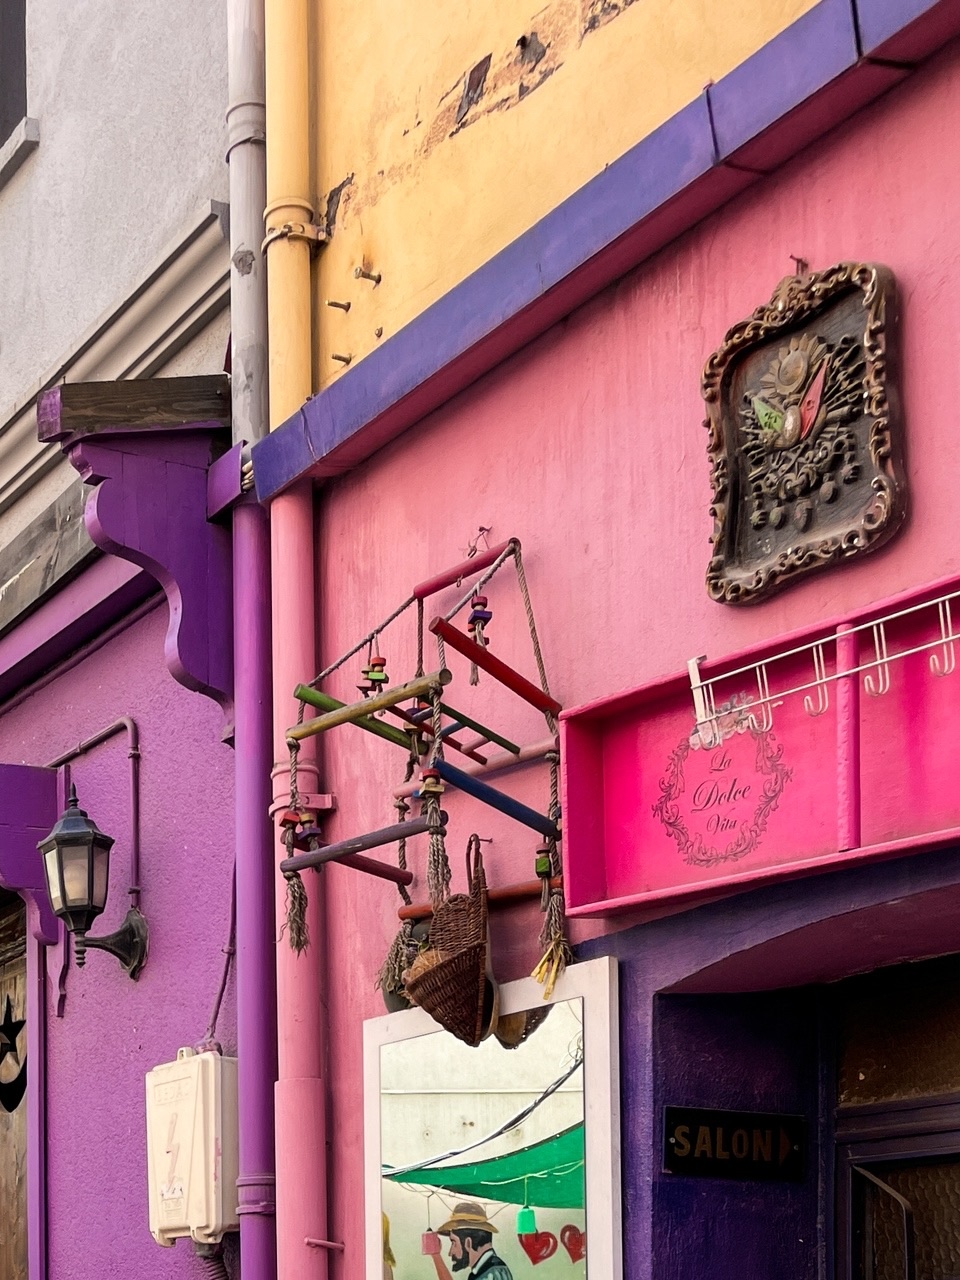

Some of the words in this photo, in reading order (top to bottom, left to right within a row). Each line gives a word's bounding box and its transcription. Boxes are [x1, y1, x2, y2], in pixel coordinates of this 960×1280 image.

[709, 750, 733, 774] La
[691, 778, 752, 813] Dolce
[706, 808, 738, 835] Vita
[673, 1125, 773, 1162] SALON
